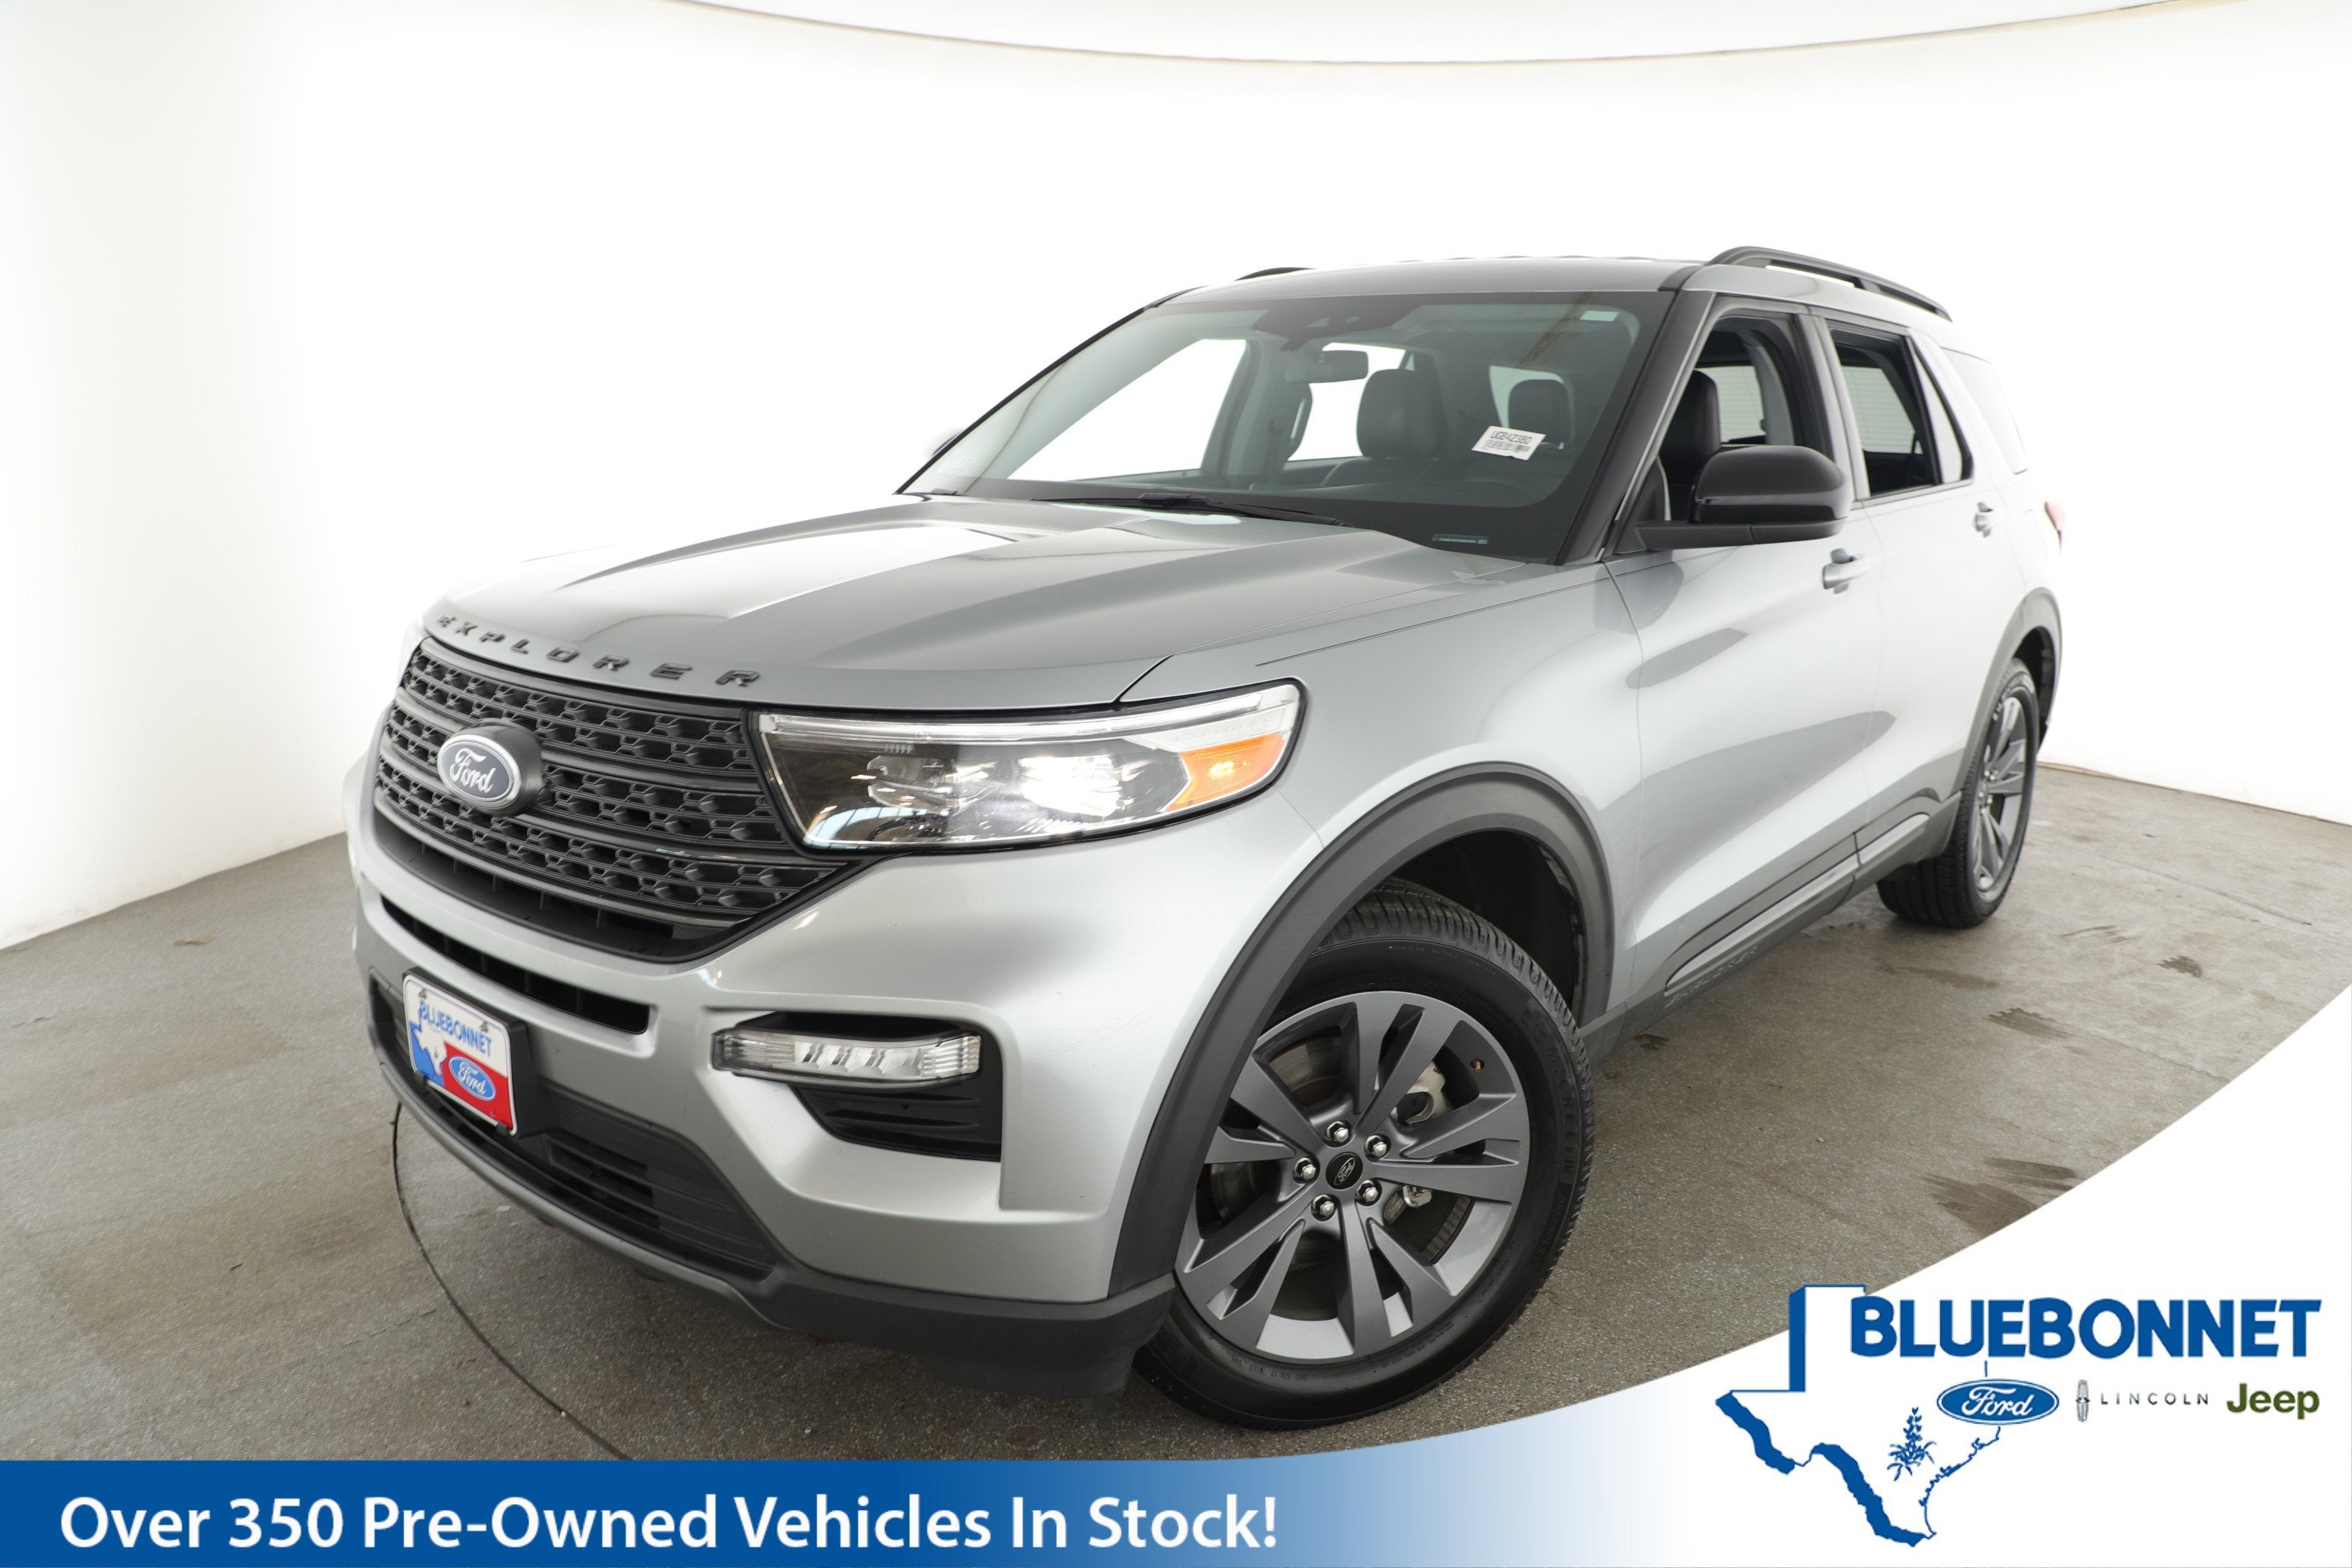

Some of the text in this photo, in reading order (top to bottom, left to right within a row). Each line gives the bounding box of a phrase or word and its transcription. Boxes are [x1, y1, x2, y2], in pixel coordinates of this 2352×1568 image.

[436, 615, 761, 687] EXPLORER
[1176, 718, 1276, 743] EXPLORER
[448, 746, 495, 793] Ford
[418, 1000, 492, 1058] BLUEBONNET
[458, 1061, 487, 1095] Ford
[1545, 1046, 1575, 1175] MICHELIN
[1538, 1196, 1566, 1256] DEFENDER
